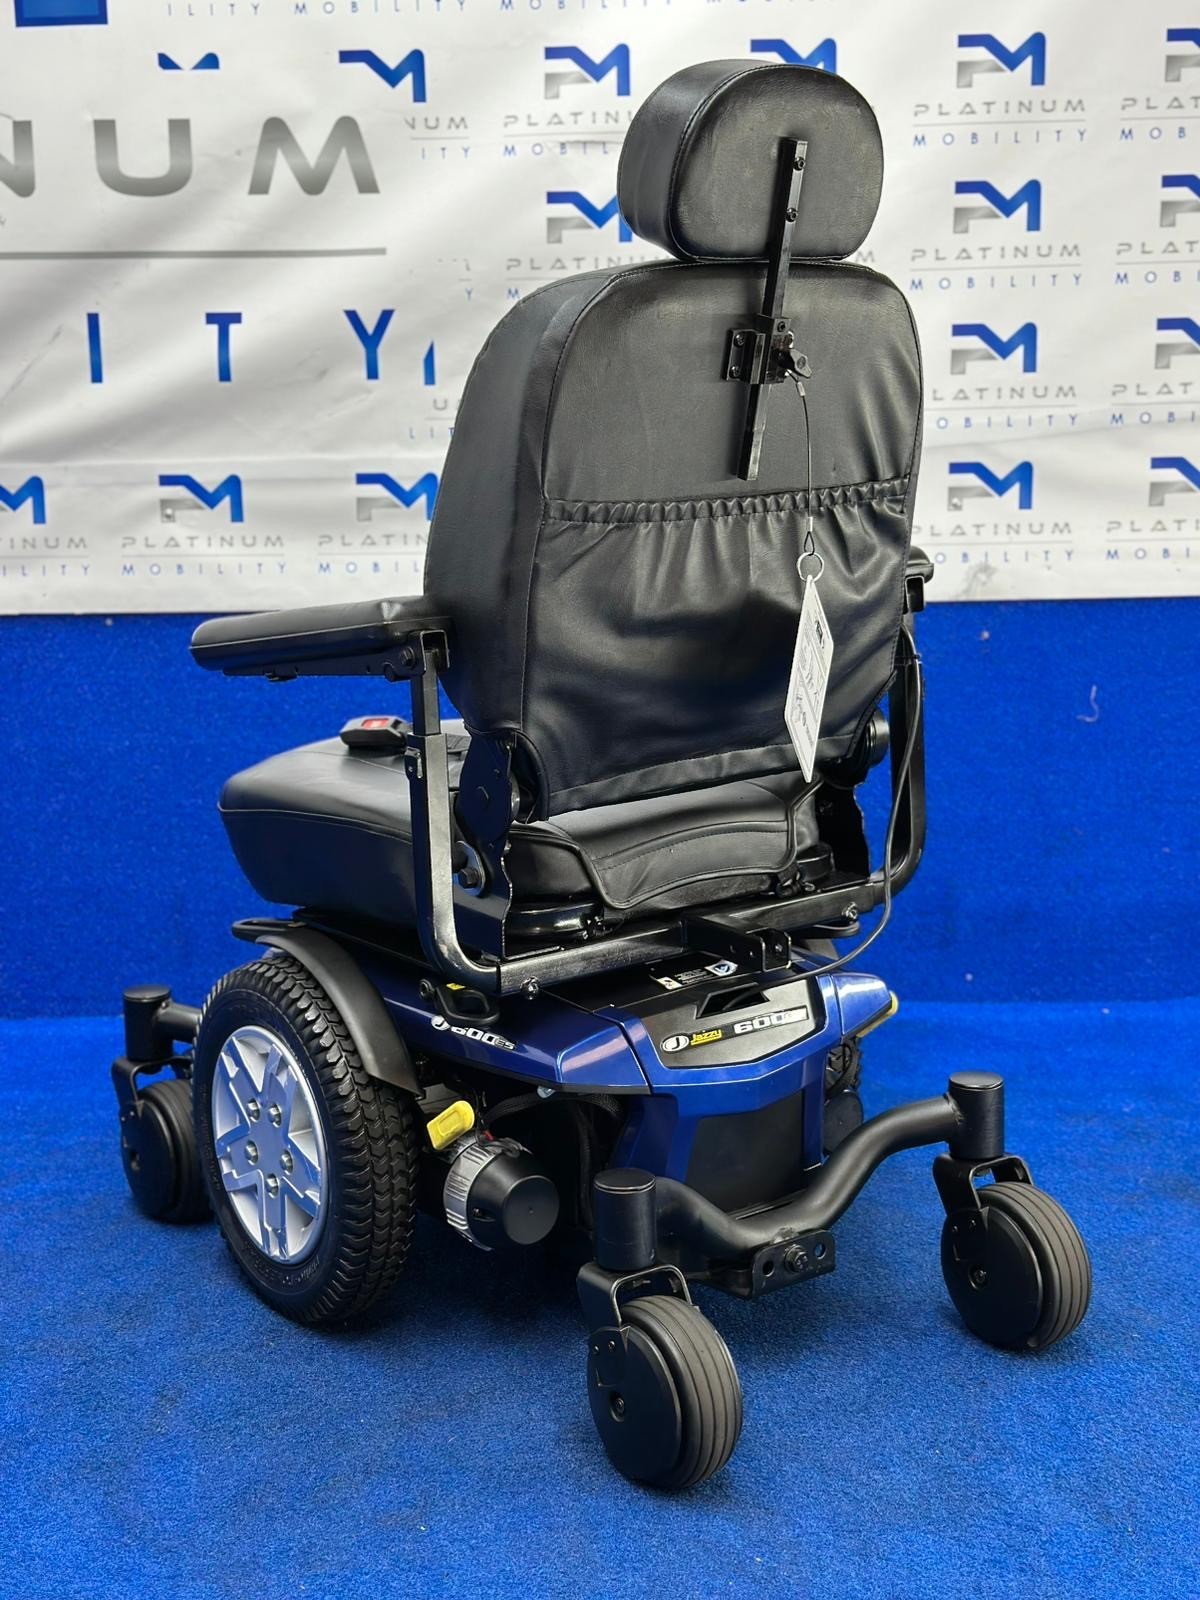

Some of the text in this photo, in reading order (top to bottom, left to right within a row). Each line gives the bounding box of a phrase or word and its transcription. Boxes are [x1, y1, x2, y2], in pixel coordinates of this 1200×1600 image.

[294, 0, 466, 15] MOBILITY
[913, 98, 1086, 117] PLATINUM
[913, 129, 1087, 147] MOBILITY
[910, 244, 1081, 262] PLATINUM
[909, 274, 1082, 291] MOBILITY
[121, 535, 285, 549] PLATINUM
[121, 562, 287, 577] MOBILITY
